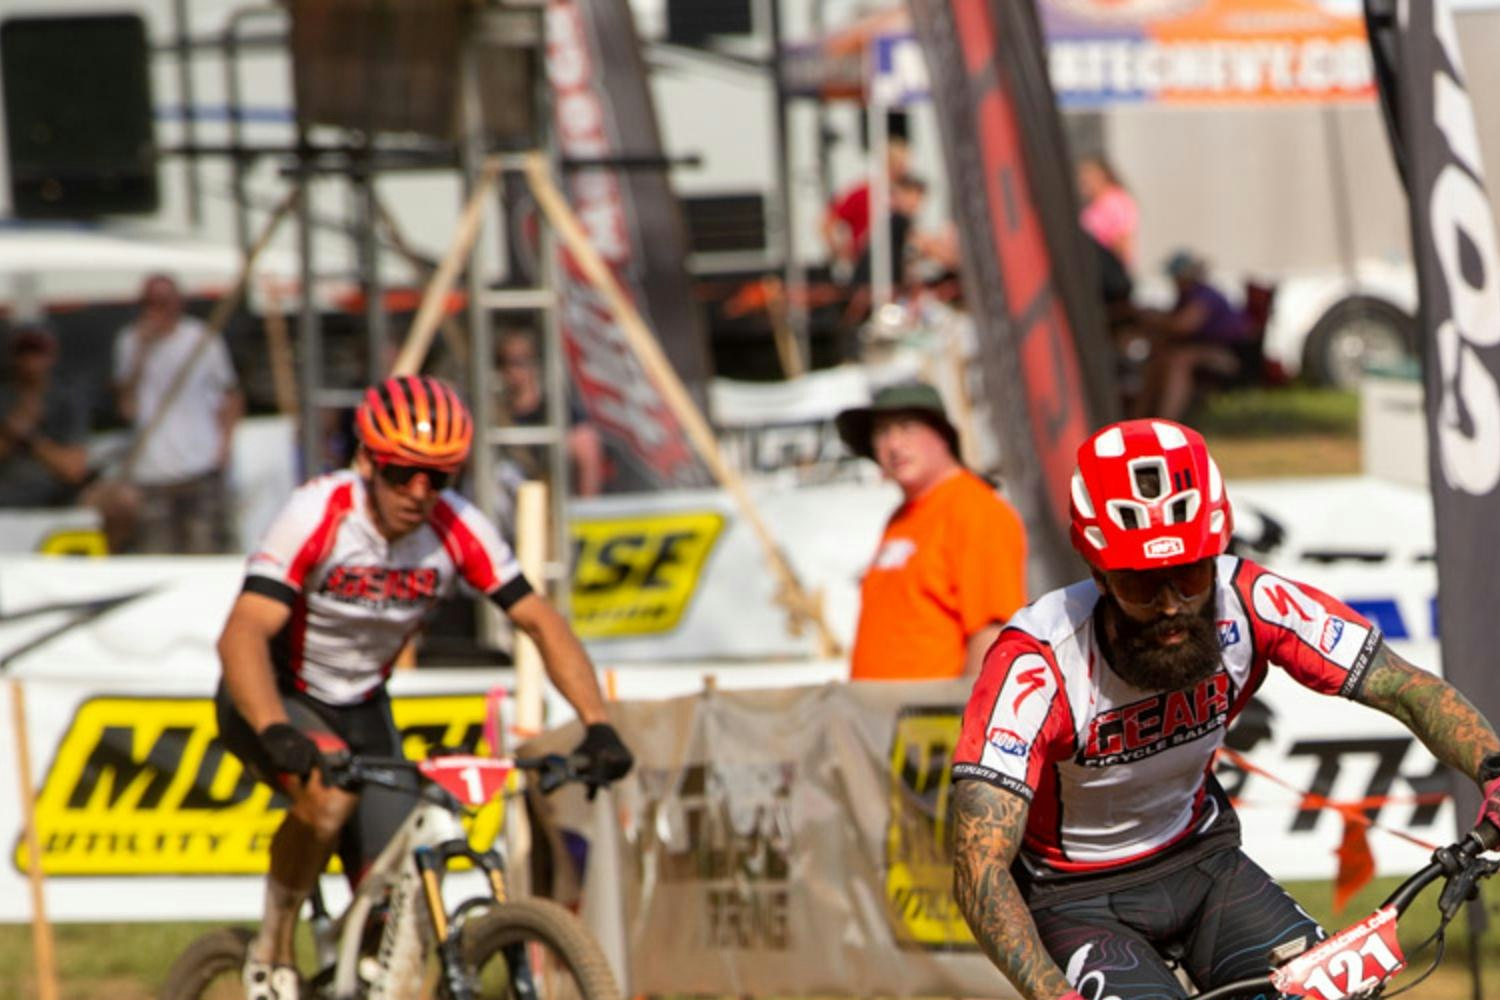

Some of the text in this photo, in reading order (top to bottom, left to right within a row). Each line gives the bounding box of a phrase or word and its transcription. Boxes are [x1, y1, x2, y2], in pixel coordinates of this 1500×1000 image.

[1085, 670, 1231, 758] GEAR
[1172, 713, 1228, 744] SALES
[458, 766, 485, 805] 1
[46, 832, 224, 853] UTILITY
